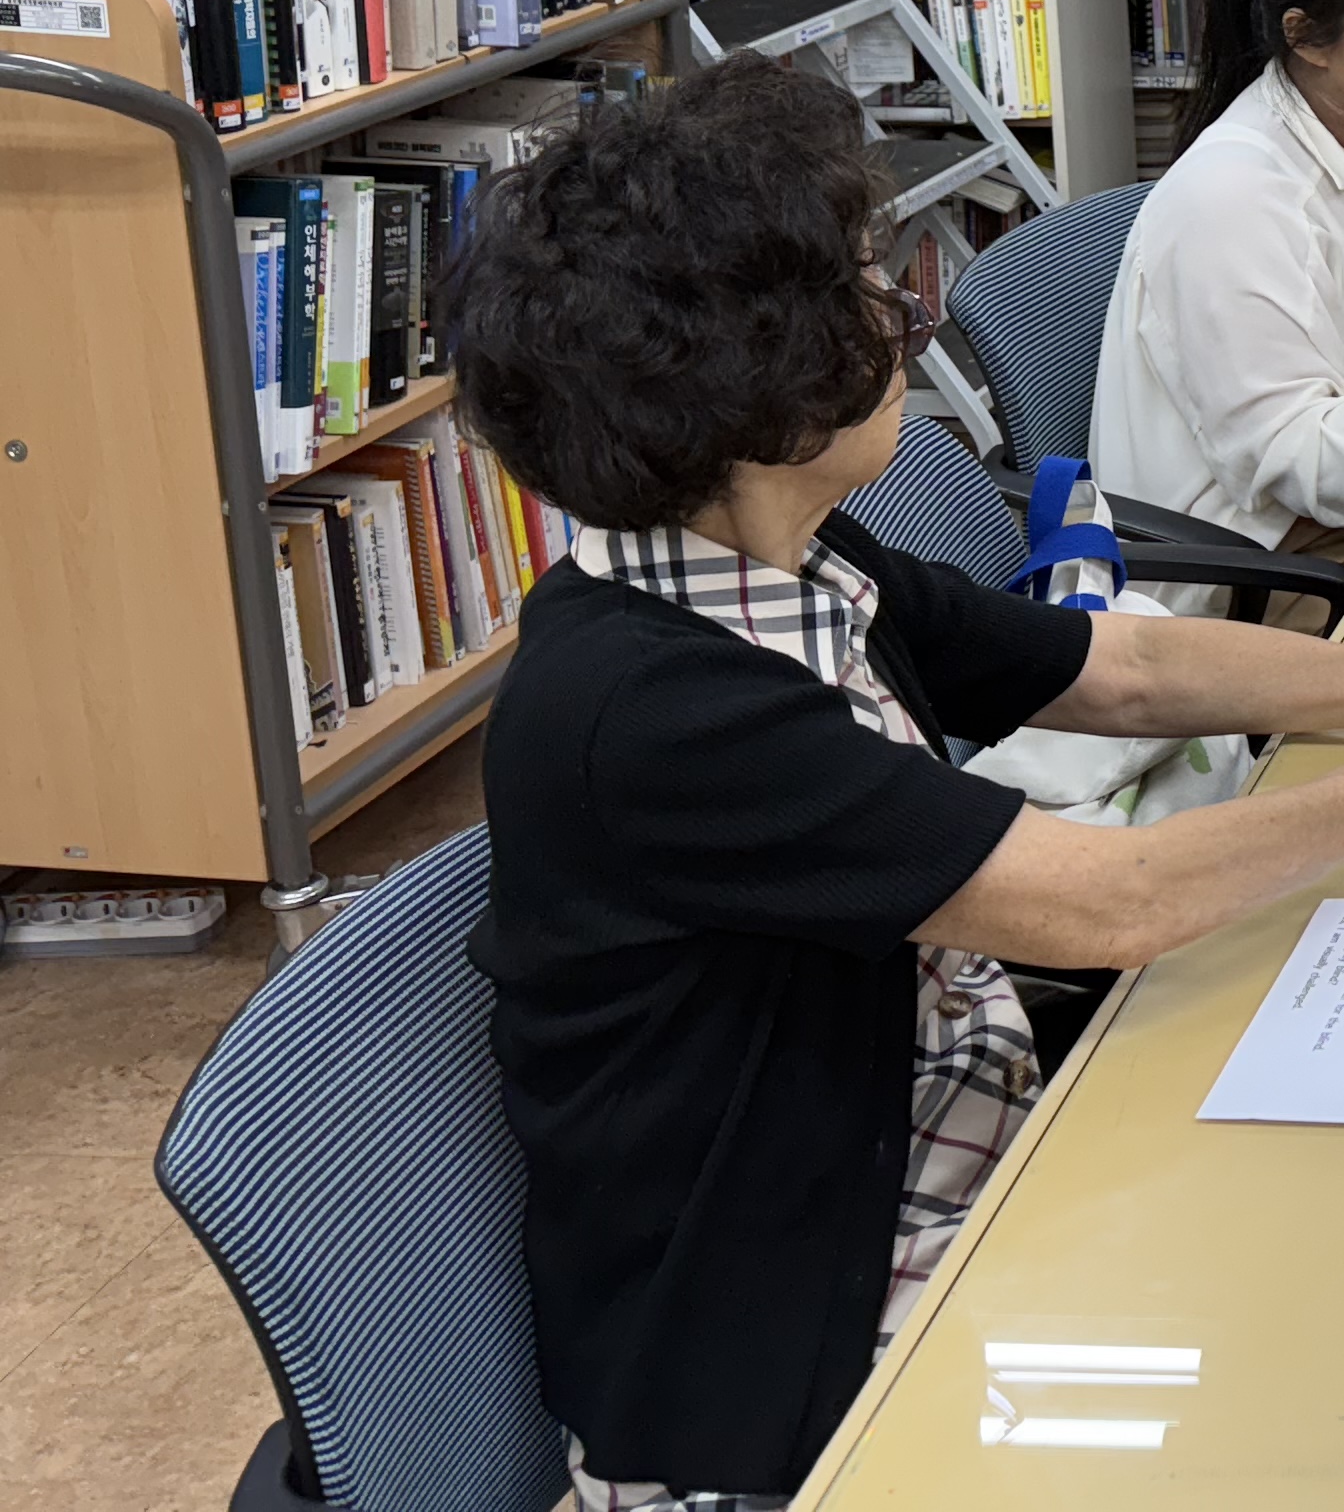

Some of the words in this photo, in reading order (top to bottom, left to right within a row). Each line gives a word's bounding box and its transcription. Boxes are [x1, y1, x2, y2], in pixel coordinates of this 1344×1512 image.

[303, 224, 316, 320] 인체해부학
[1330, 933, 1341, 944] am
[1313, 946, 1336, 969] visually
[1328, 965, 1344, 986] blind?
[1292, 973, 1321, 1010] challenged.
[1325, 1018, 1341, 1029] the
[1312, 1032, 1333, 1052] blind.
